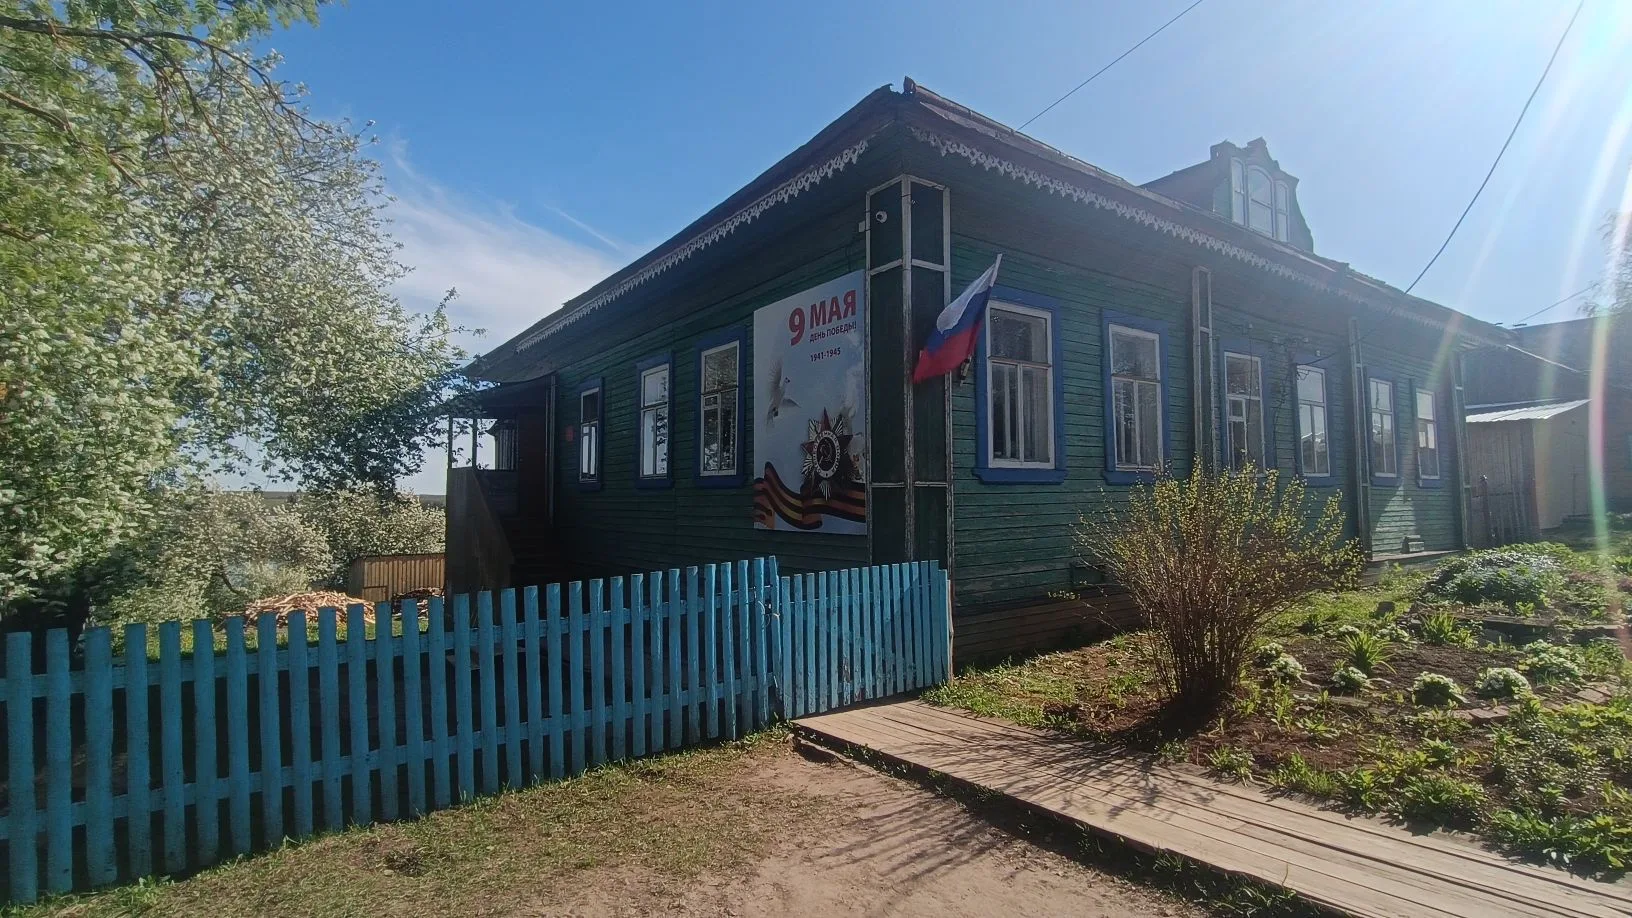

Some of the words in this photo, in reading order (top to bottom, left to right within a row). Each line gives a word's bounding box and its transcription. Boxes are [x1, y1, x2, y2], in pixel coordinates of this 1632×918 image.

[788, 307, 805, 346] 9
[810, 290, 856, 329] МАЯ
[810, 330, 825, 342] ДЕНЬ
[826, 321, 857, 337] ПОБЕДЫ!
[810, 347, 841, 361] 1941-1945
